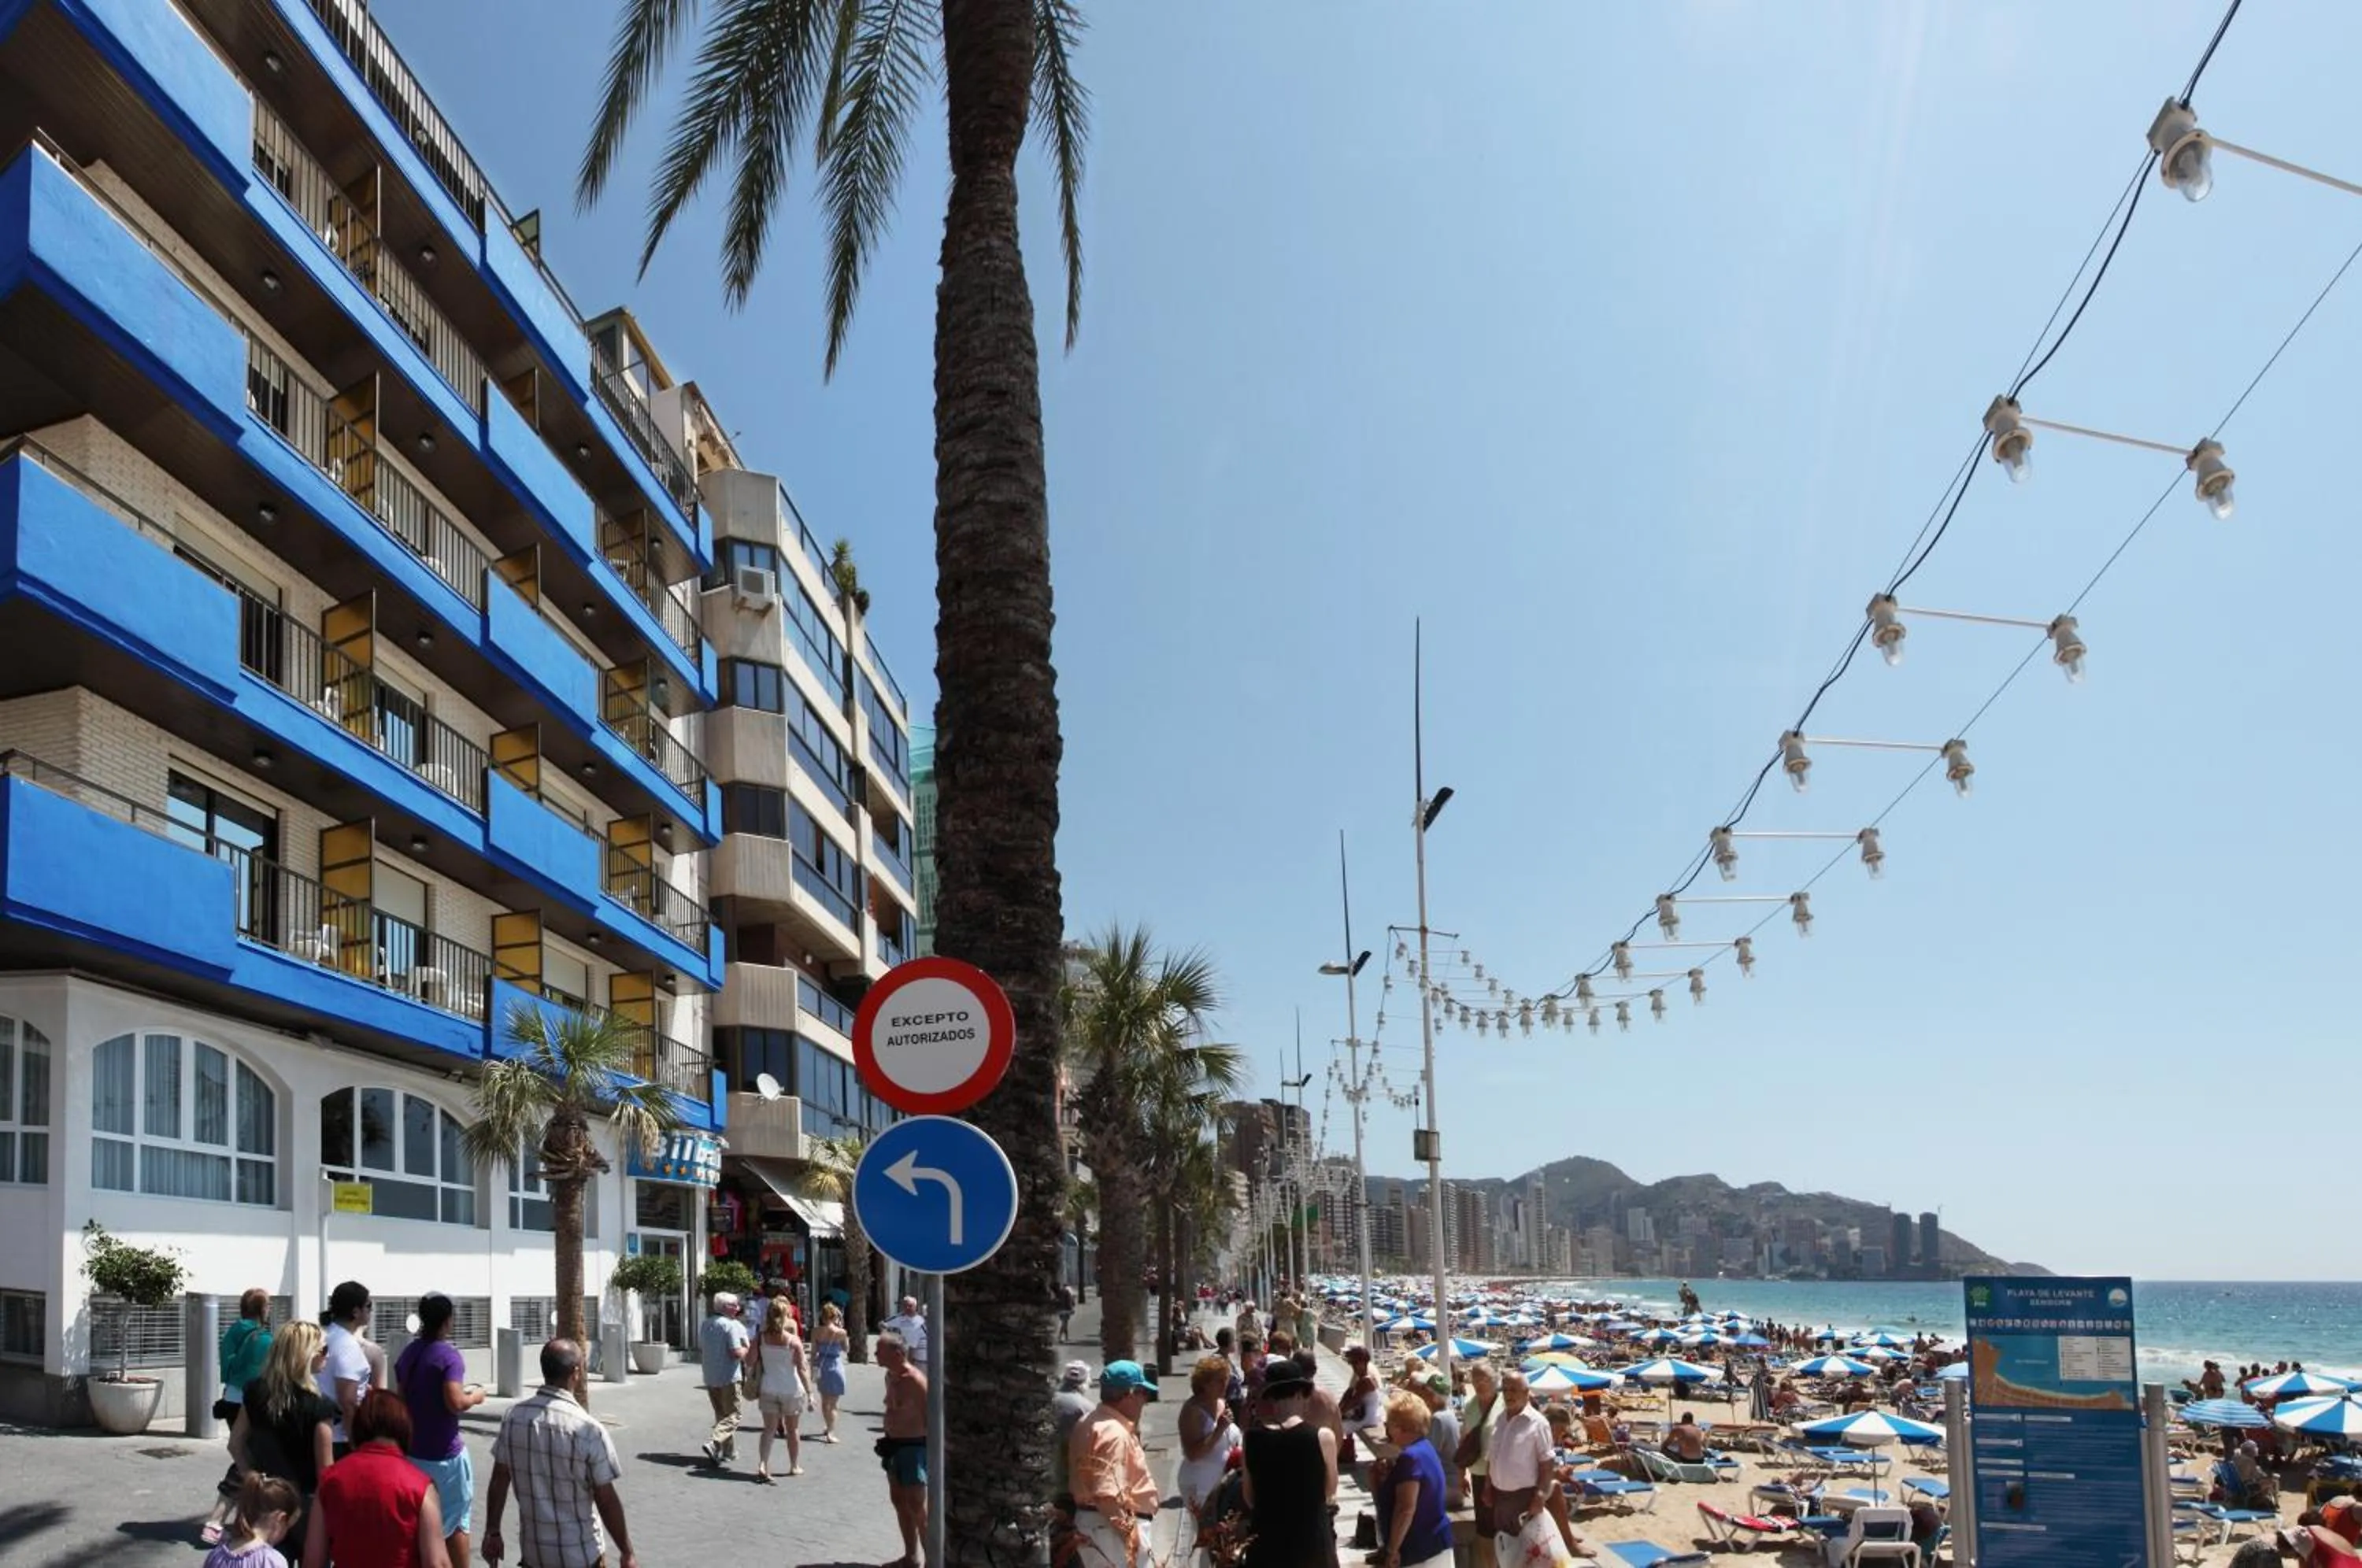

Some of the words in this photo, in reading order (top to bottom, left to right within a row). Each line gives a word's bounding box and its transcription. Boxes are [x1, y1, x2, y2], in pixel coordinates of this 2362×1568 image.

[890, 1011, 969, 1027] EXCEPTO
[887, 1028, 976, 1047] AUTORIZADOS
[2006, 1289, 2035, 1298] PLAYA
[2052, 1289, 2095, 1299] LEVANTE
